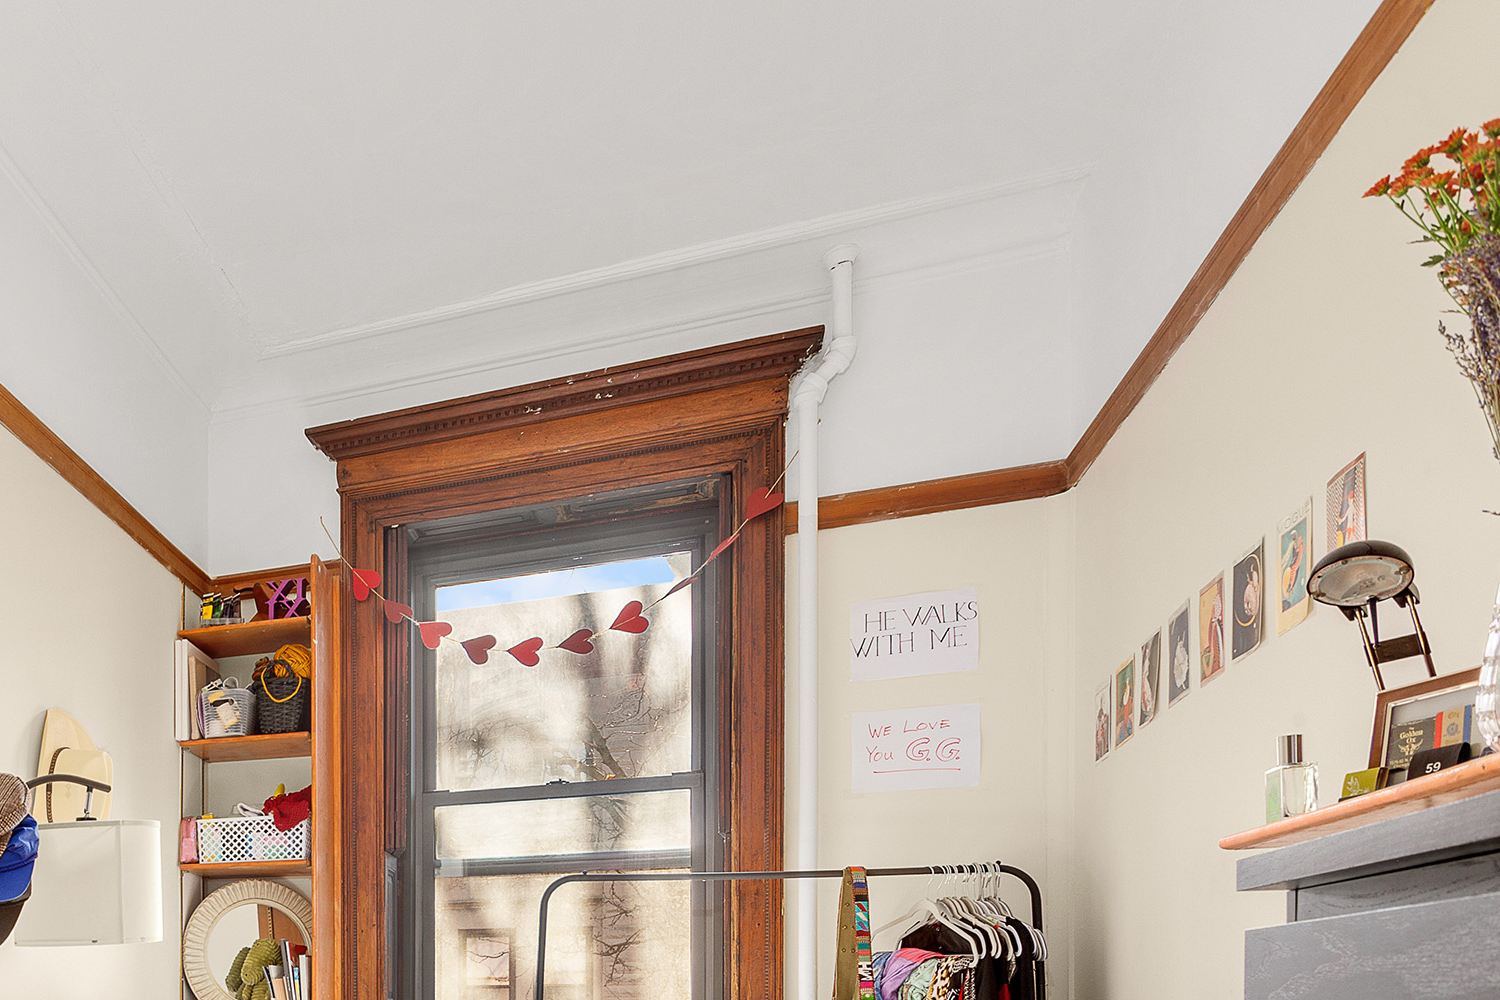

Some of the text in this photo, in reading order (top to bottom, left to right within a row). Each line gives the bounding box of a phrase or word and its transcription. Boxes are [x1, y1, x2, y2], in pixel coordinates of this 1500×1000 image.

[864, 601, 978, 633] HE WALKS
[850, 625, 968, 658] WITH ME
[868, 719, 951, 738] WE LOVE
[1400, 729, 1424, 740] Golden
[1425, 761, 1441, 774] 59
